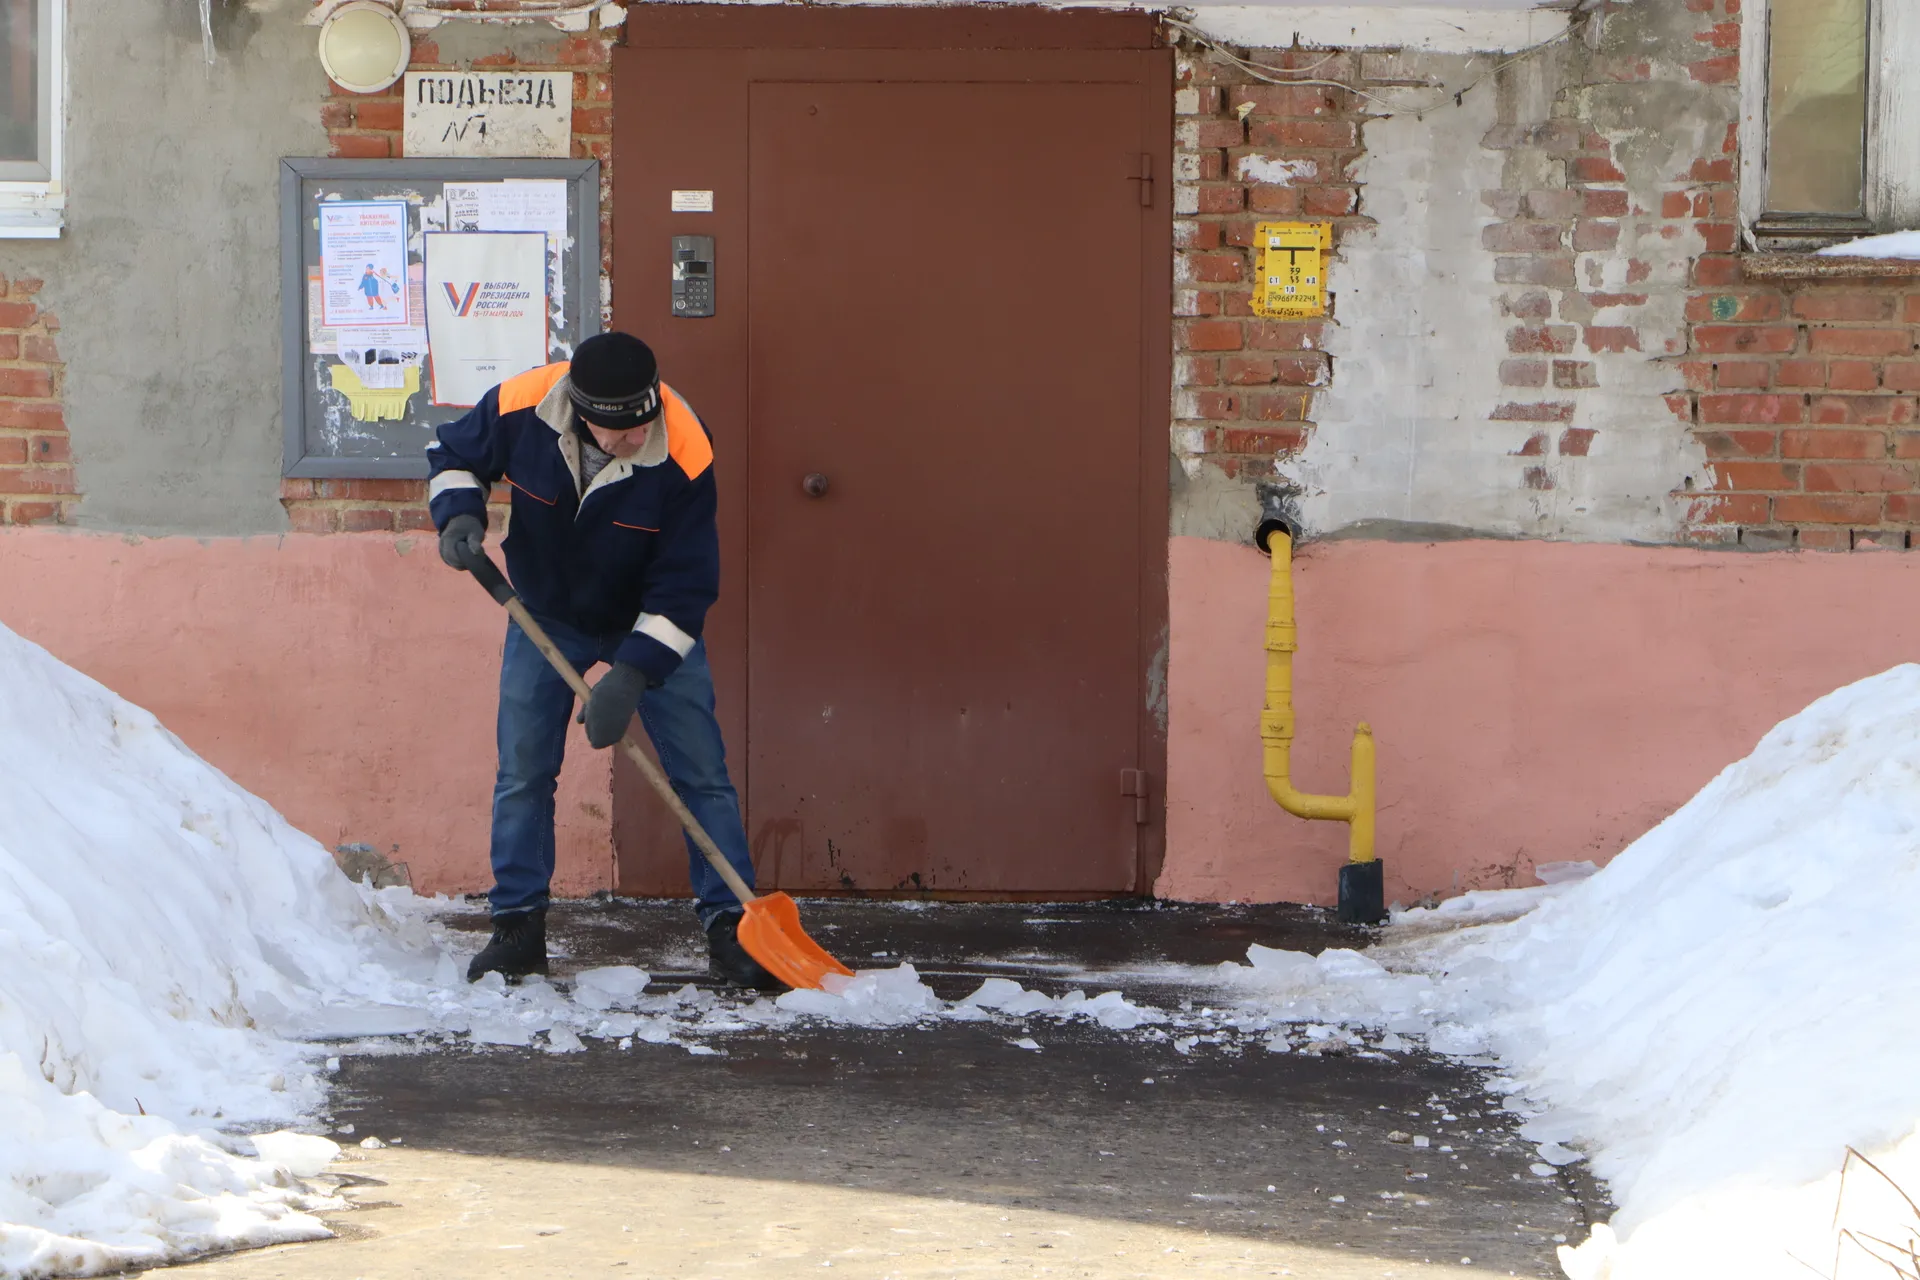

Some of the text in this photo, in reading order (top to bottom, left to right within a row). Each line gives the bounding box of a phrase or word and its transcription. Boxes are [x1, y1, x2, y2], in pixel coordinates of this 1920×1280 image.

[483, 282, 520, 290] ВЫБОРЫ
[479, 291, 530, 300] ПРЕЗИДЕНТА
[475, 301, 509, 309] РОССИИ
[592, 403, 624, 411] adidas
